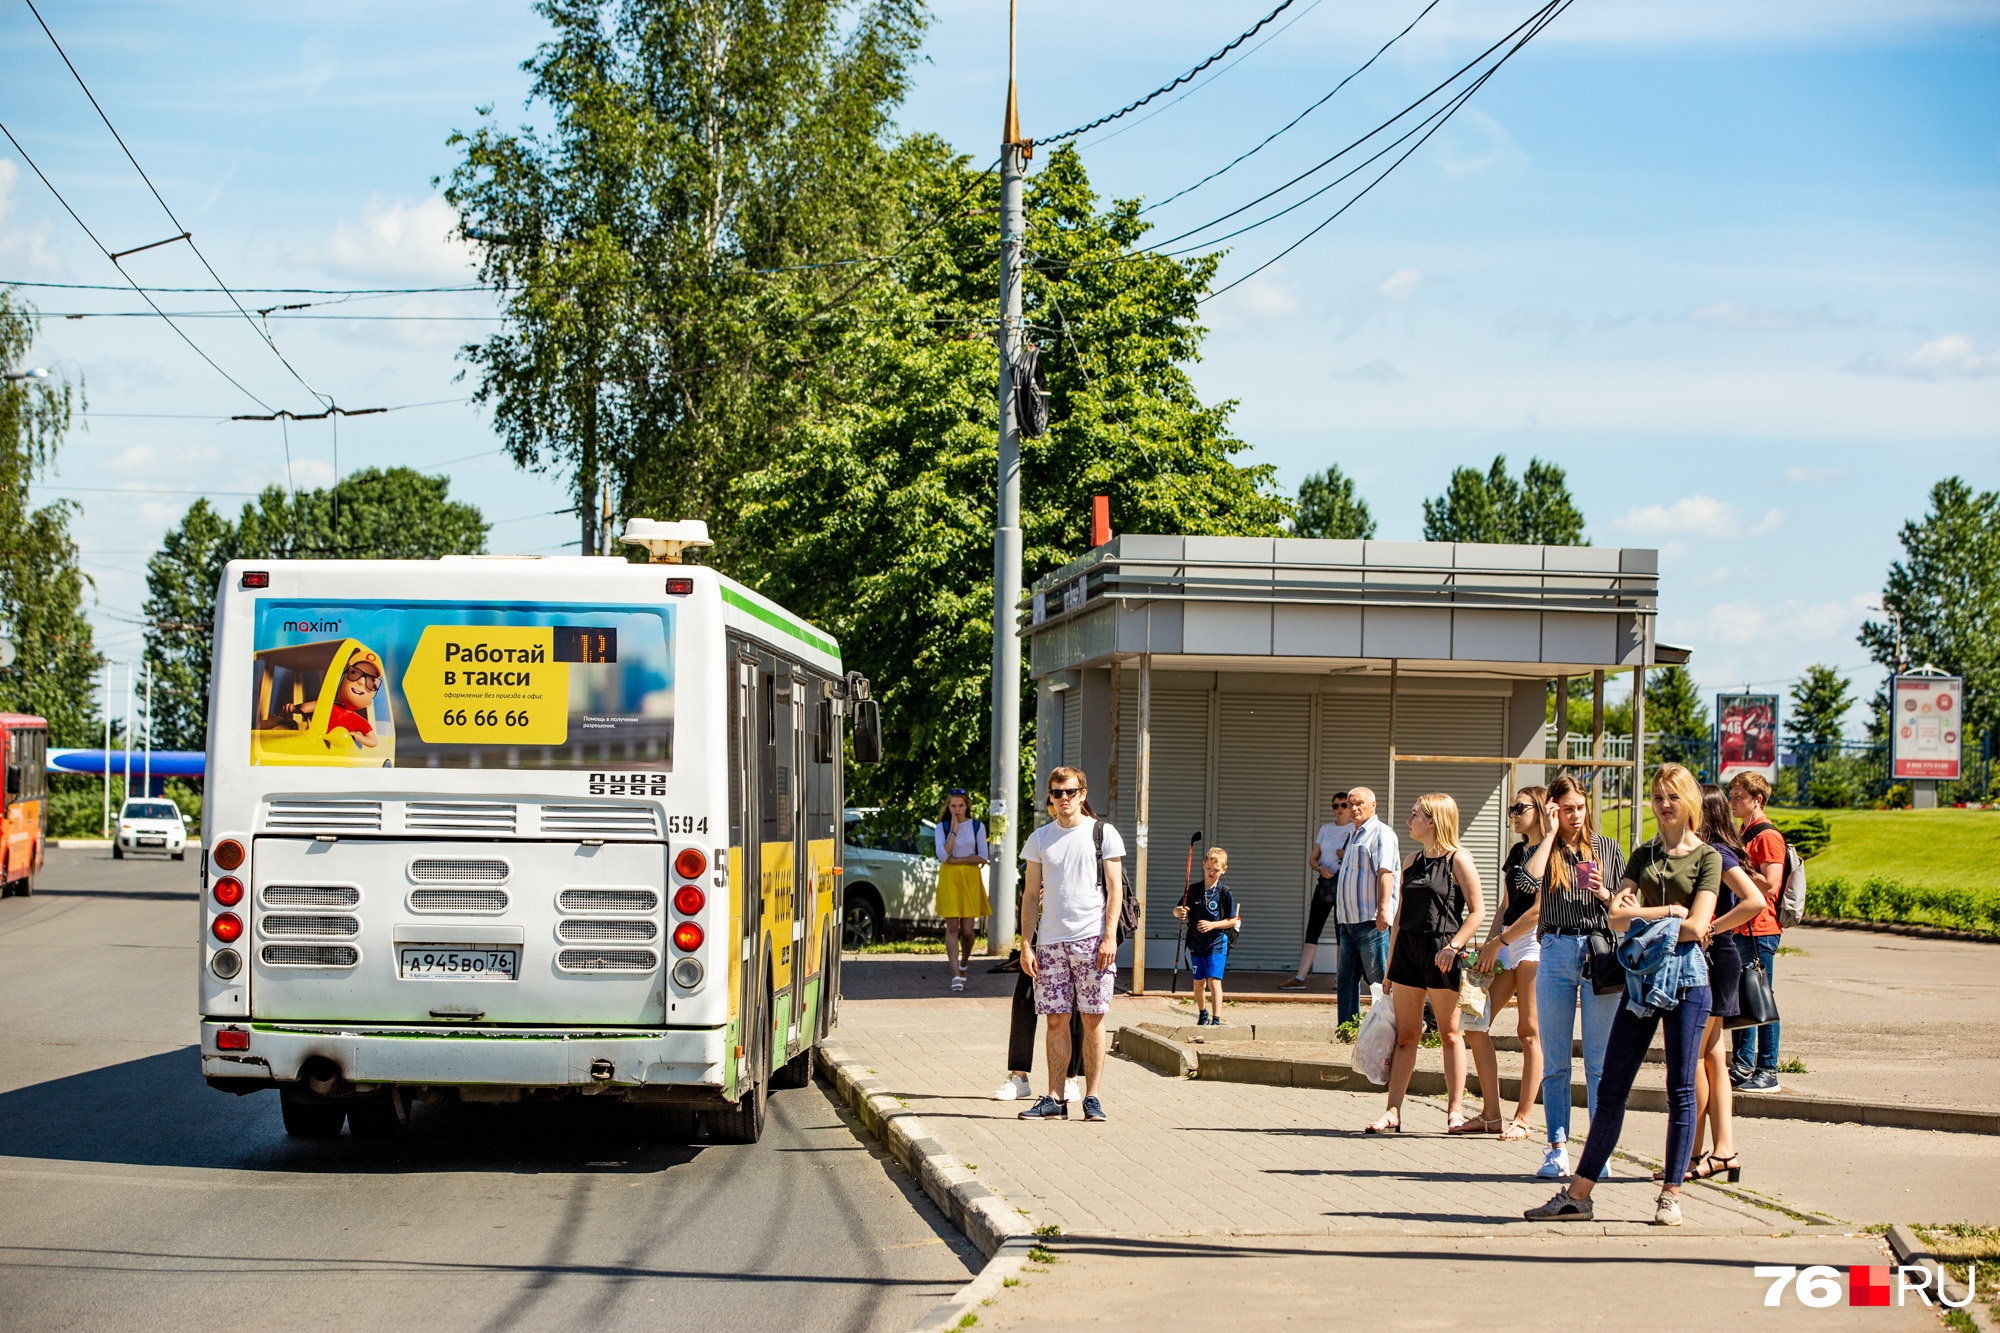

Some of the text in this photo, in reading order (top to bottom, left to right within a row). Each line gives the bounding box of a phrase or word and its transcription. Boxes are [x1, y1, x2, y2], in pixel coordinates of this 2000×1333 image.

[283, 617, 338, 632] maxim
[445, 642, 545, 664] Работай
[444, 671, 530, 686] в такси
[443, 709, 529, 727] 66 66 66
[1727, 721, 1742, 735] 46
[589, 785, 666, 796] 5256
[669, 815, 709, 835] 594
[489, 953, 508, 968] 76
